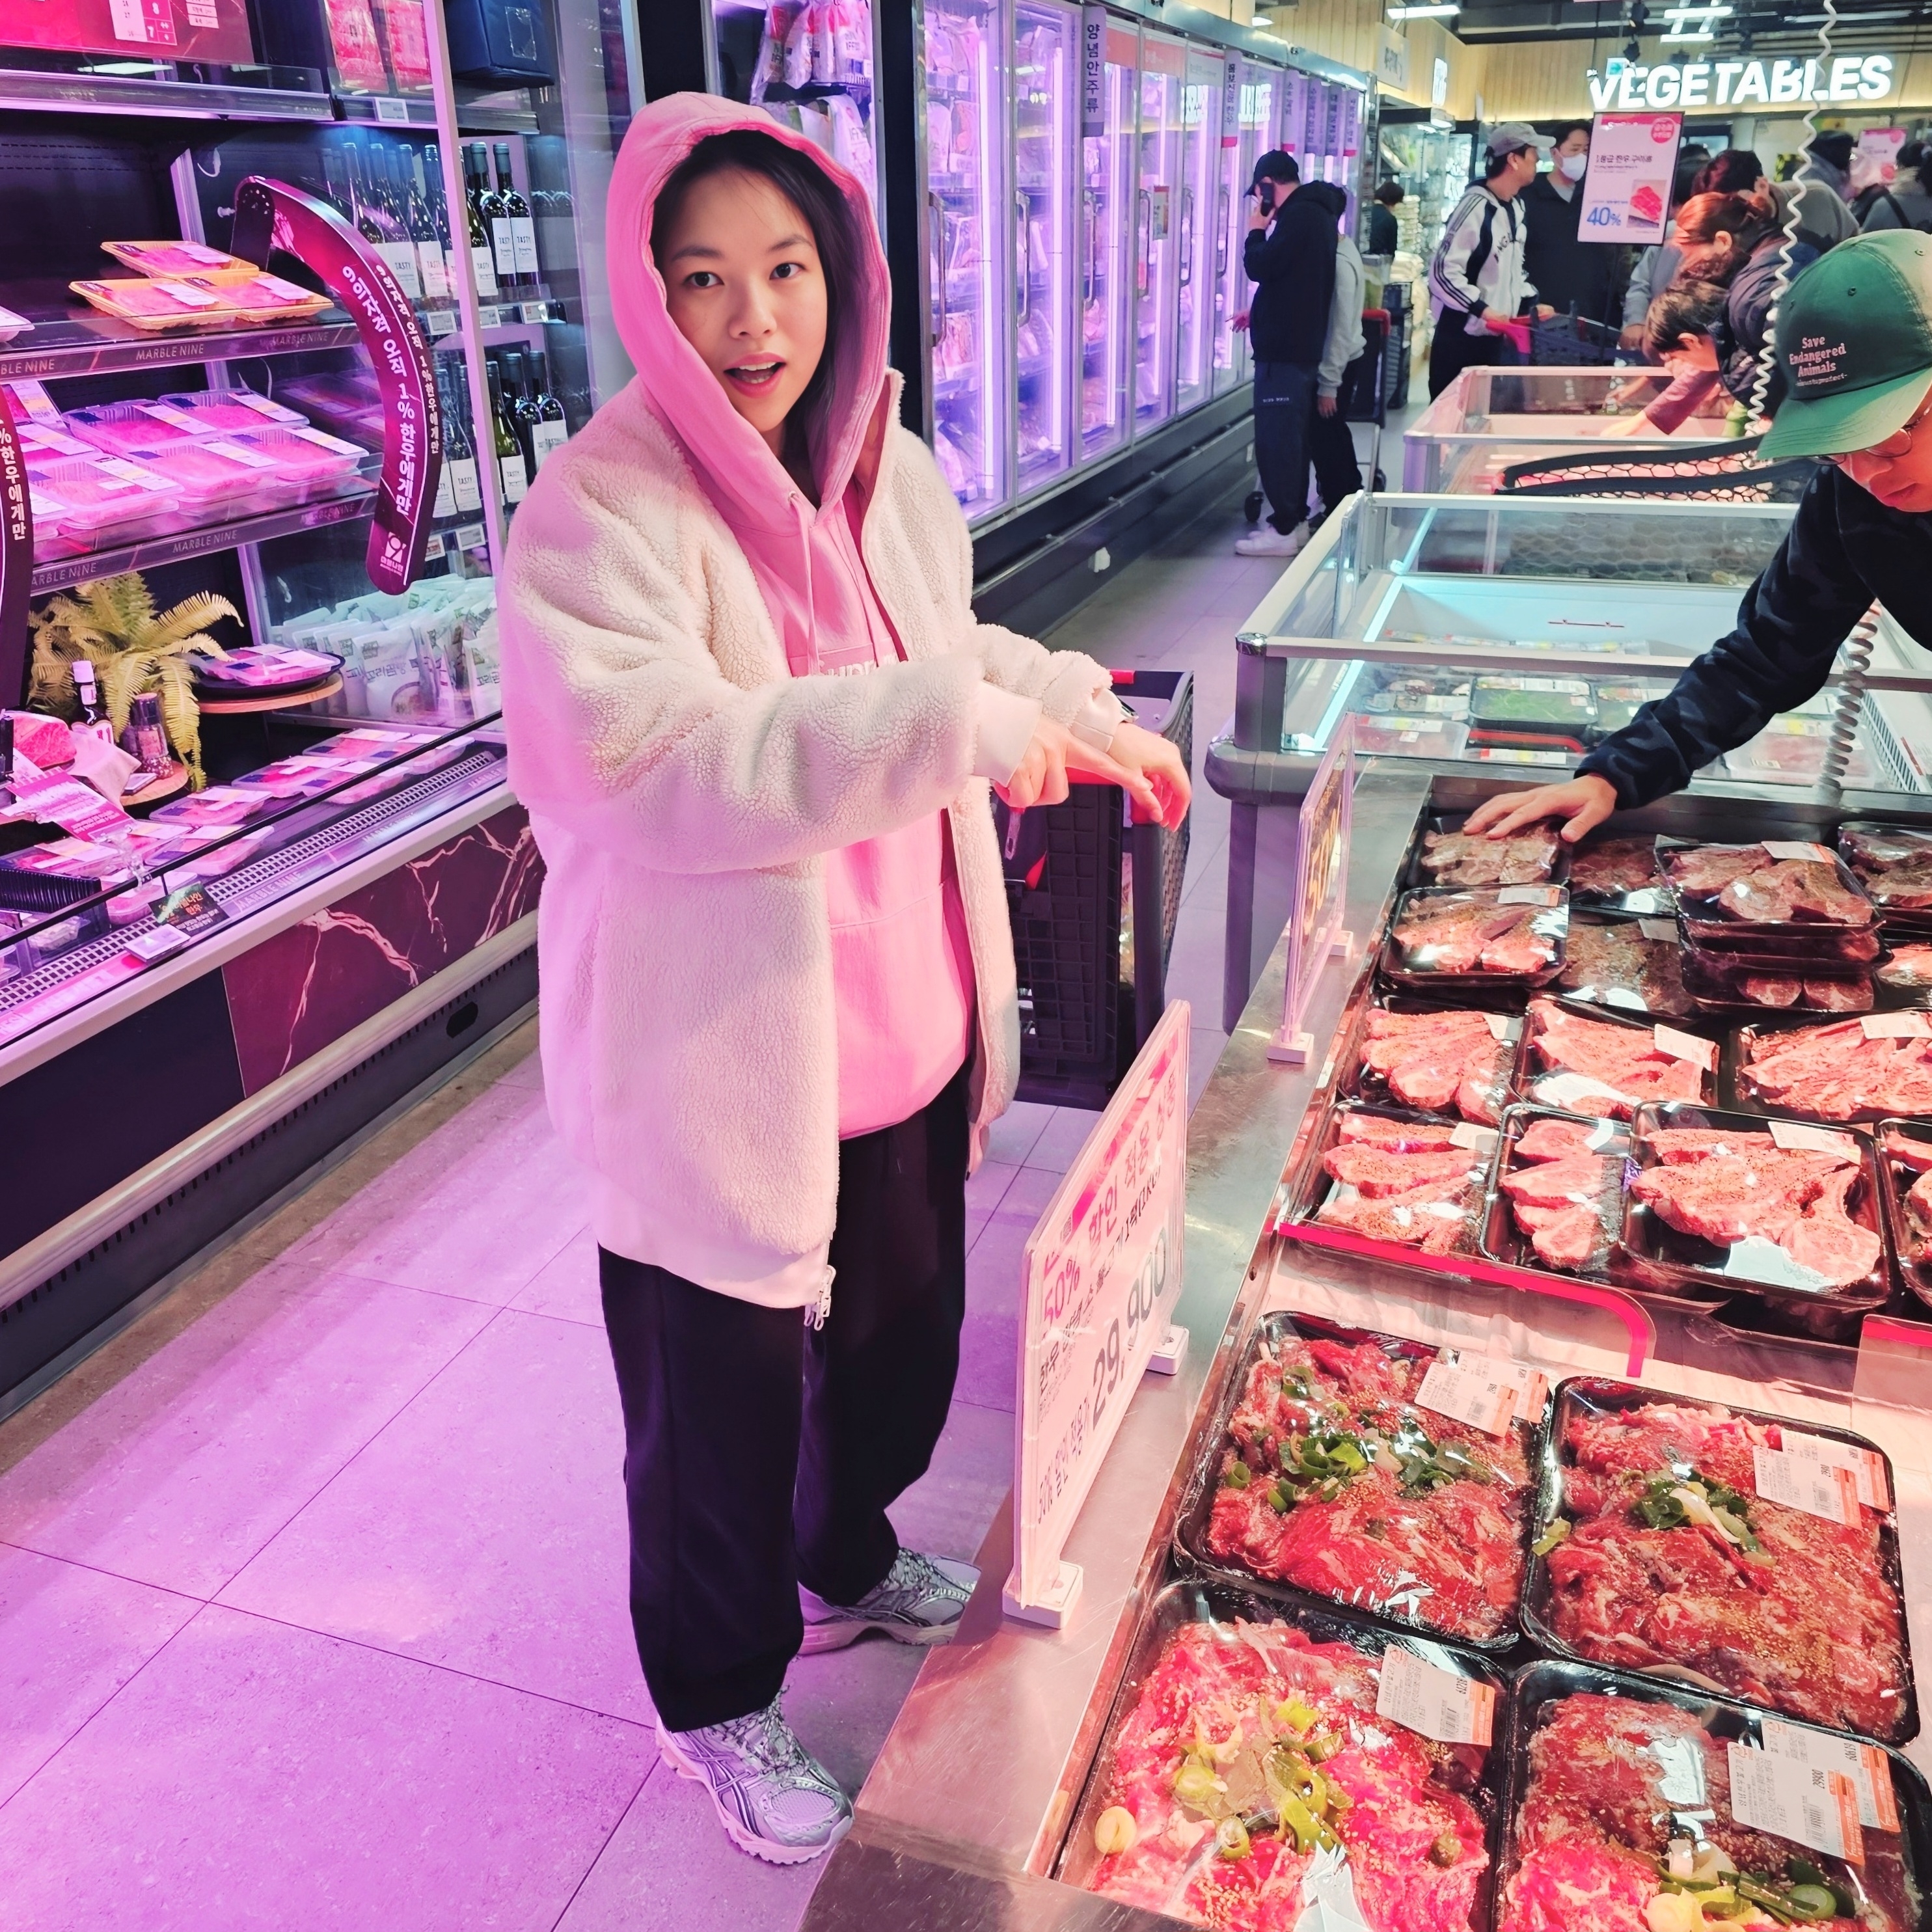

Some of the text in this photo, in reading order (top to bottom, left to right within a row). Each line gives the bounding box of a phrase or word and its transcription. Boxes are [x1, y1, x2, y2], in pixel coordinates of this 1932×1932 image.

[1086, 24, 1100, 113] 양념안주류
[1588, 55, 1893, 110] VEGETABLES
[1586, 207, 1622, 226] 40%
[136, 344, 204, 360] MARBLE NINE
[1789, 342, 1847, 365] Endangered
[1802, 336, 1825, 349] Save
[0, 359, 55, 375] BLE NINE
[1798, 361, 1836, 377] Animals
[172, 530, 237, 553] MARBLE NINE
[31, 563, 96, 586] ARBLE NINE
[237, 885, 277, 909] MARBLE
[1042, 1240, 1080, 1340] 50%
[1089, 1174, 1117, 1268] 할인
[1124, 1121, 1149, 1190] 적용
[1091, 1225, 1169, 1430] 29,900
[1040, 1340, 1059, 1397] 한우
[1811, 1769, 1825, 1789] 29900
